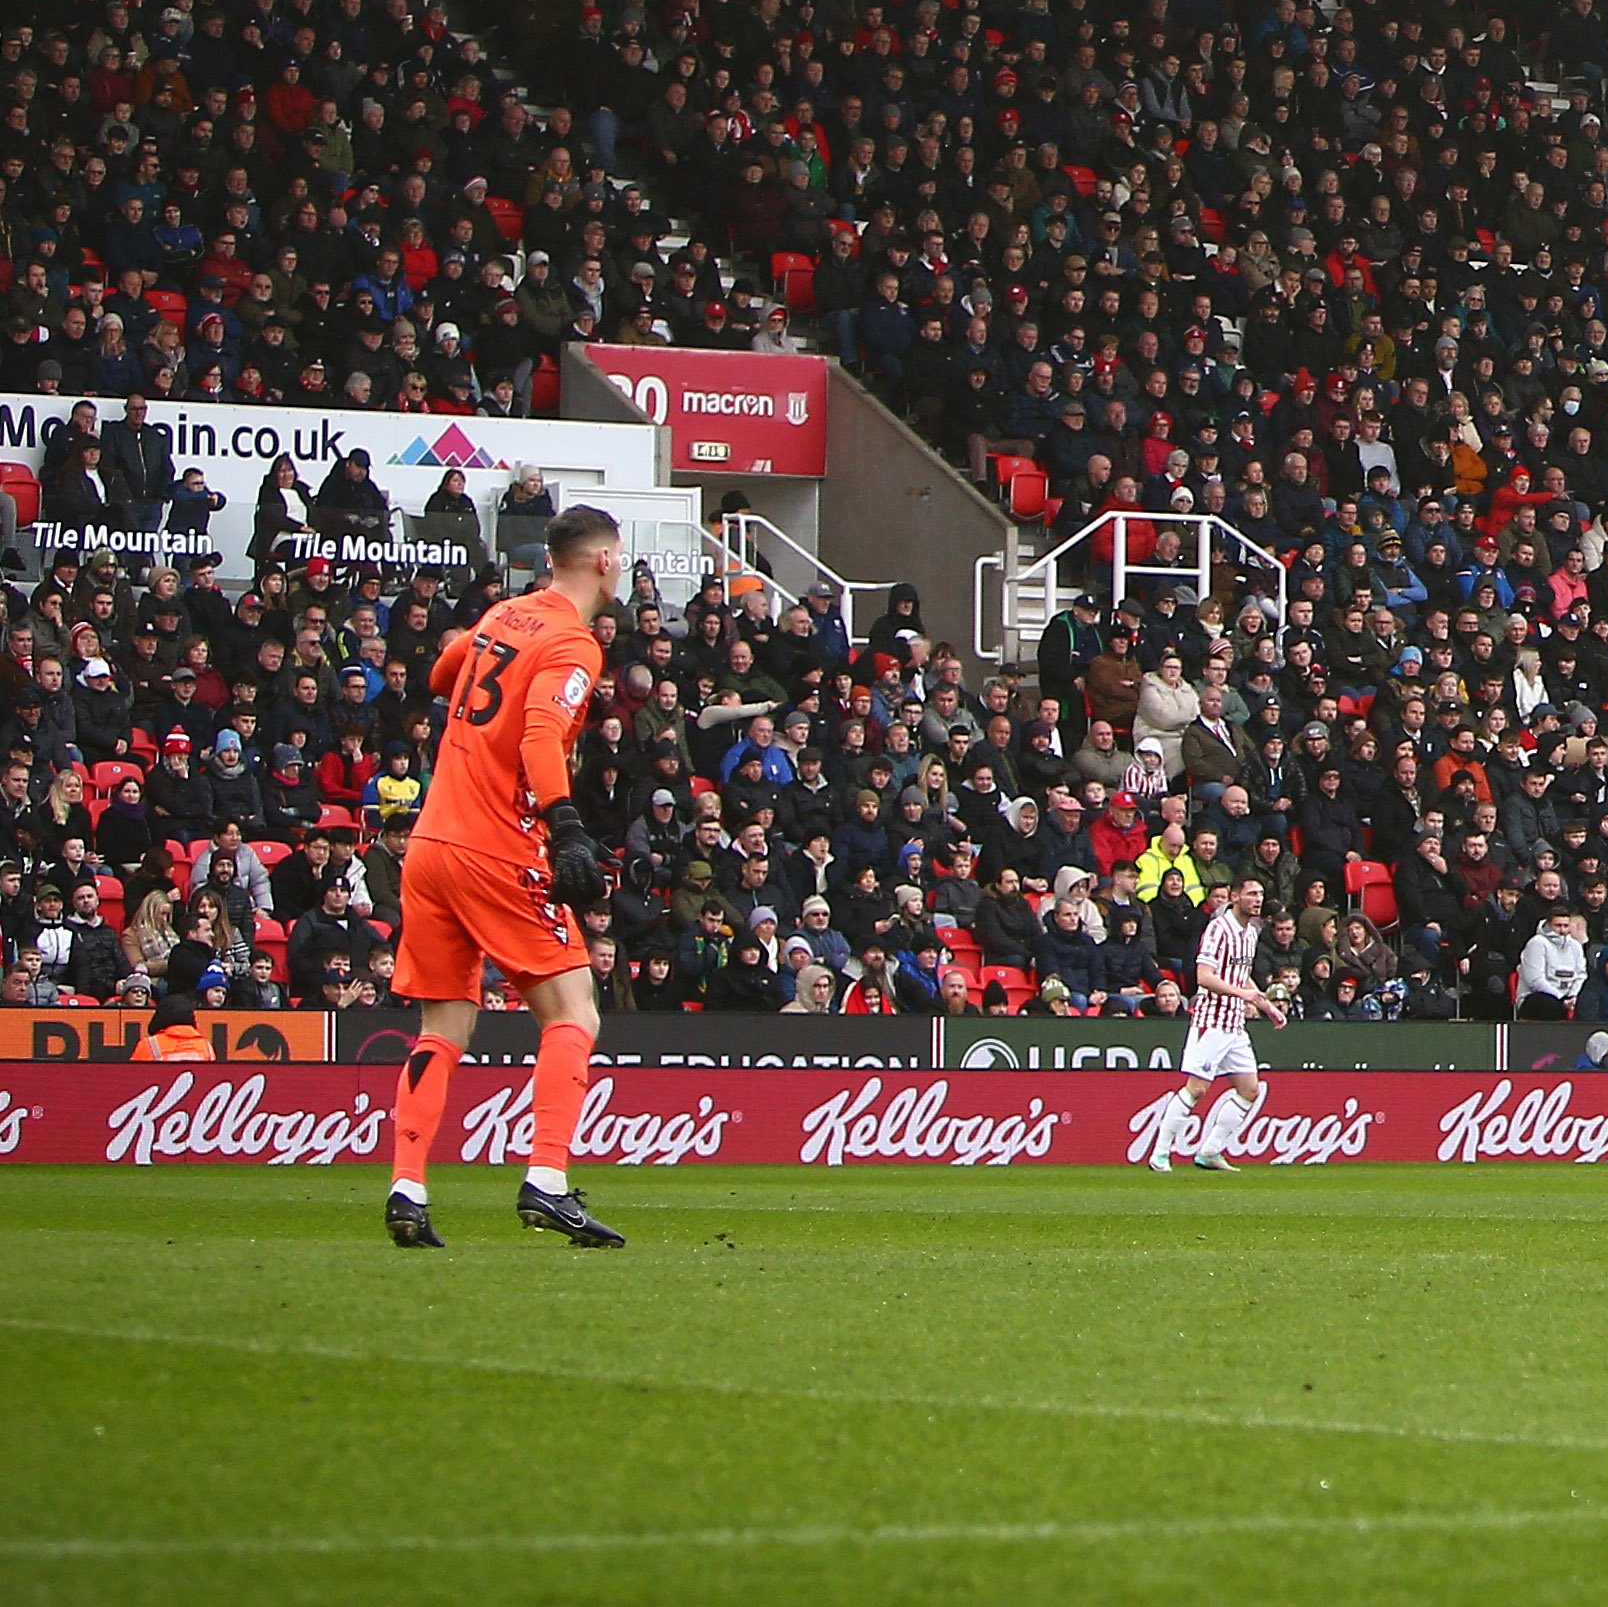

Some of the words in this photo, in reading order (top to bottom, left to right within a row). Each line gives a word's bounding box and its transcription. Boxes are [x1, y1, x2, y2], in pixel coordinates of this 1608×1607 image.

[682, 390, 774, 417] macron
[31, 521, 78, 550] Tile
[84, 524, 214, 556] Mountain
[291, 533, 337, 561] Tile
[342, 535, 468, 567] Mountain
[618, 549, 715, 575] ountain
[451, 633, 520, 726] 13
[106, 1070, 386, 1166] Kellogg's
[461, 1076, 730, 1166] Kelogg's
[800, 1076, 1059, 1166] Kellogg's
